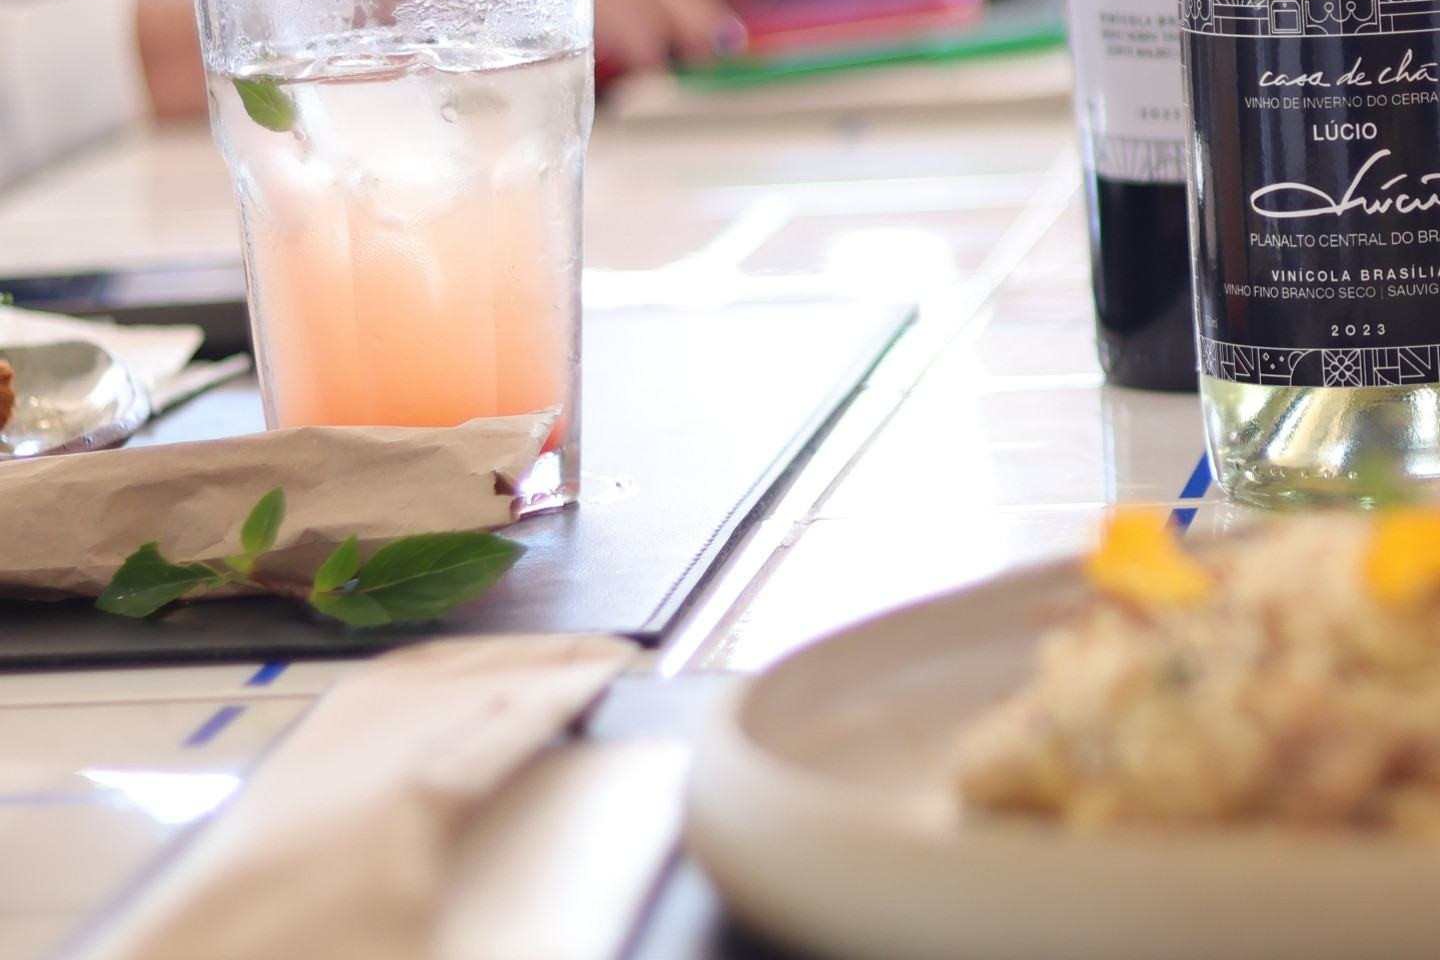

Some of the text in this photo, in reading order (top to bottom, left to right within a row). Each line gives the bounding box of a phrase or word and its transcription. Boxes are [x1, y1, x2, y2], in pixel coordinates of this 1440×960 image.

[1259, 71, 1331, 88] casa
[1336, 56, 1372, 86] de
[1245, 96, 1279, 109] VINHO
[1283, 96, 1300, 109] DE
[1303, 95, 1362, 110] INVERNO
[1367, 94, 1388, 107] DO
[1313, 120, 1378, 141] LÚCIO
[1250, 232, 1315, 248] PLANALTO
[1318, 232, 1388, 248] CENTRAL
[1391, 231, 1414, 245] DO
[1224, 283, 1250, 296] VINHO
[1253, 285, 1279, 298] FINO
[1281, 286, 1335, 300] BRANCO
[1338, 286, 1376, 299] SECO
[1331, 324, 1386, 337] 2023
